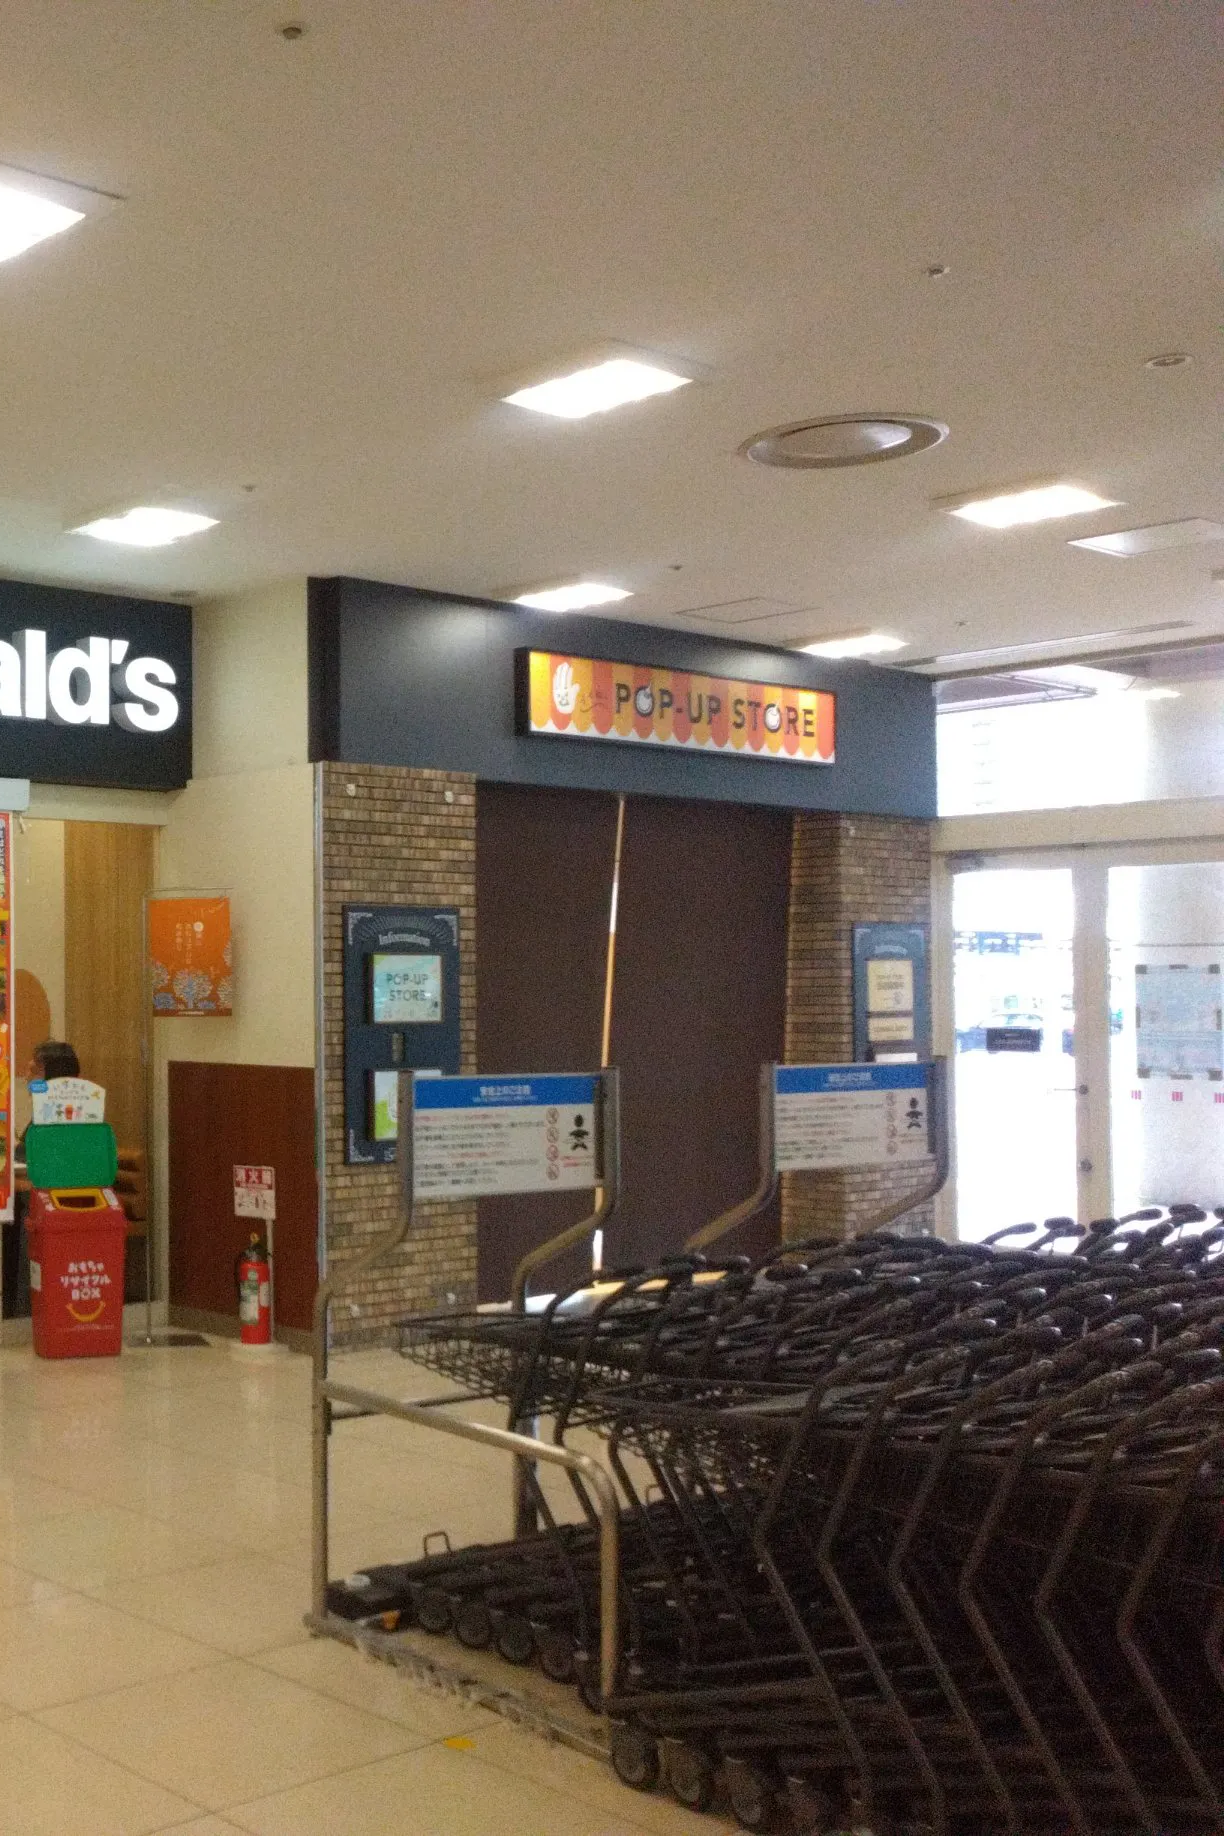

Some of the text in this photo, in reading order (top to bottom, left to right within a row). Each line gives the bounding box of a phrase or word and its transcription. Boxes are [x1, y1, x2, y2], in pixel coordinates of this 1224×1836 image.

[615, 682, 816, 738] POP-UP STORE
[385, 972, 429, 986] POP-UP
[388, 988, 427, 1002] STORE
[71, 1287, 102, 1301] BOX
